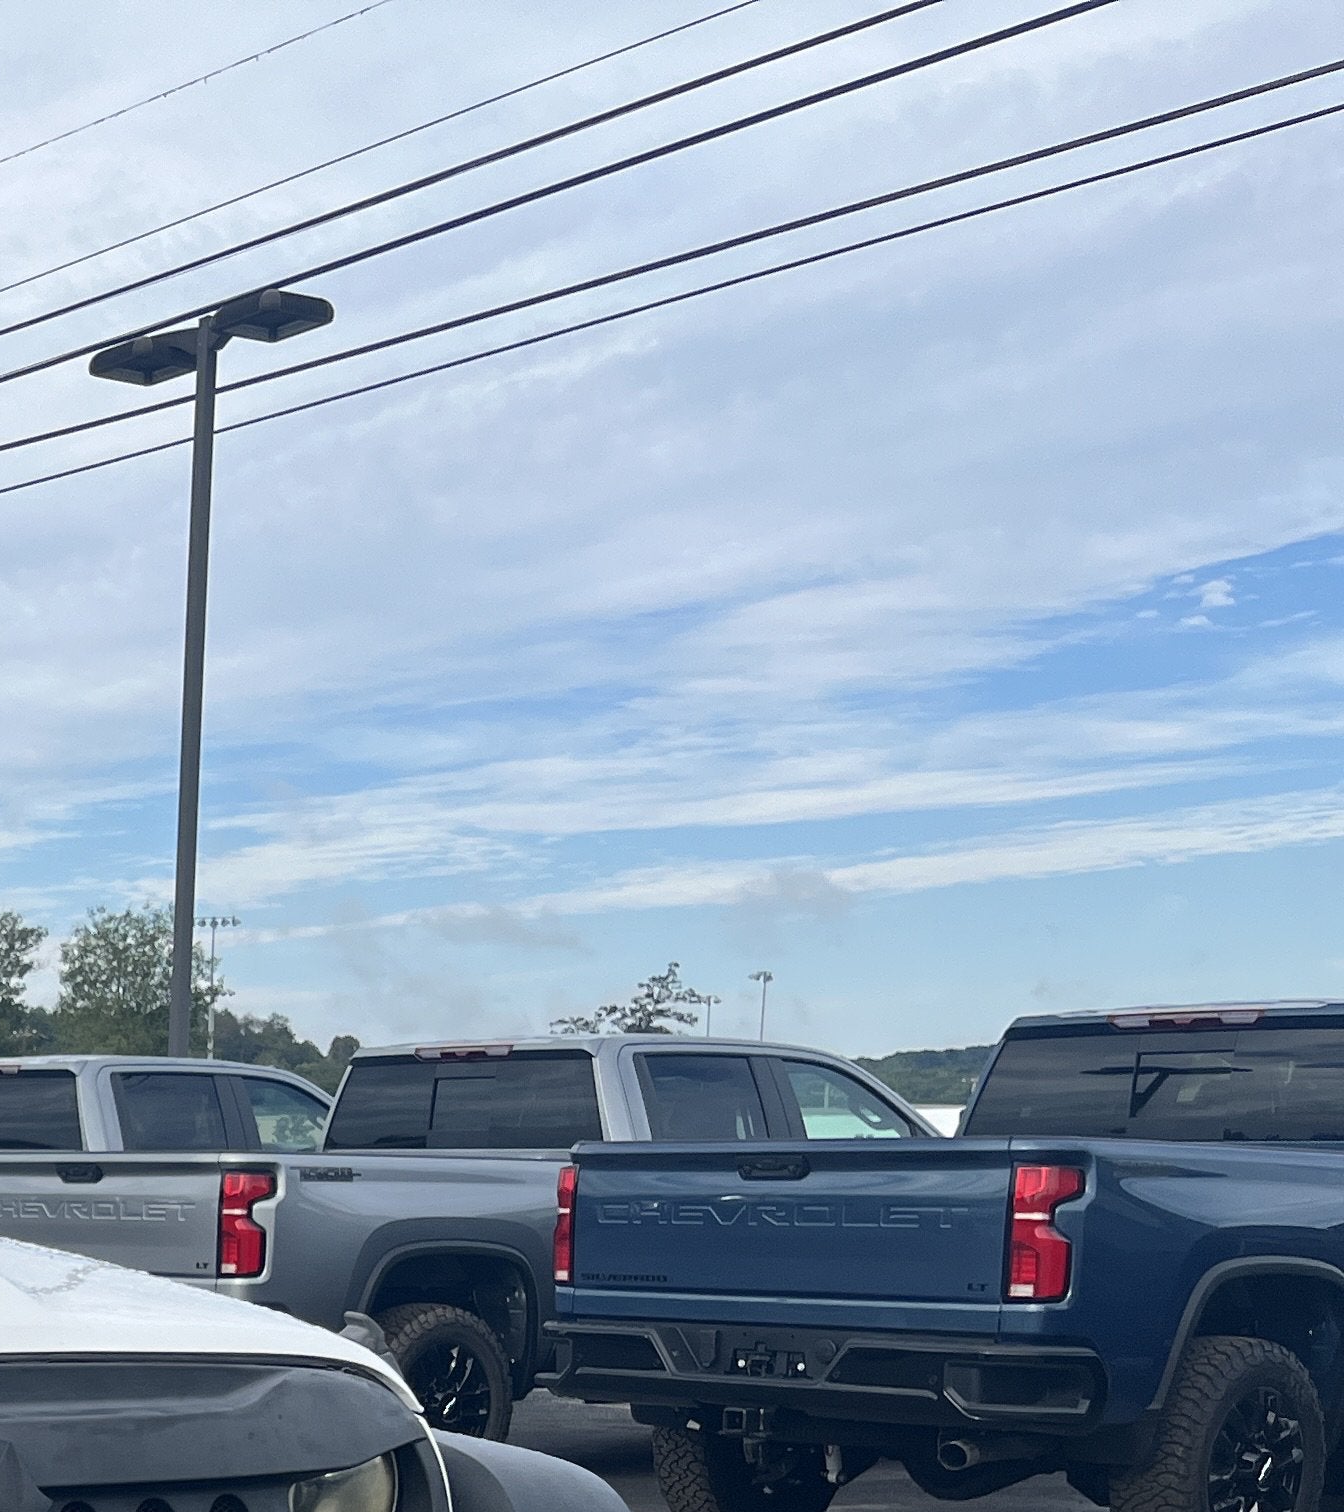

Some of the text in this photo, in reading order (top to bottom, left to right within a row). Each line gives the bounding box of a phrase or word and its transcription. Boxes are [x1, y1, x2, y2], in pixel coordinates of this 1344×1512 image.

[597, 1203, 969, 1229] CHEVROLET
[195, 1261, 209, 1270] LT
[967, 1282, 989, 1293] LT
